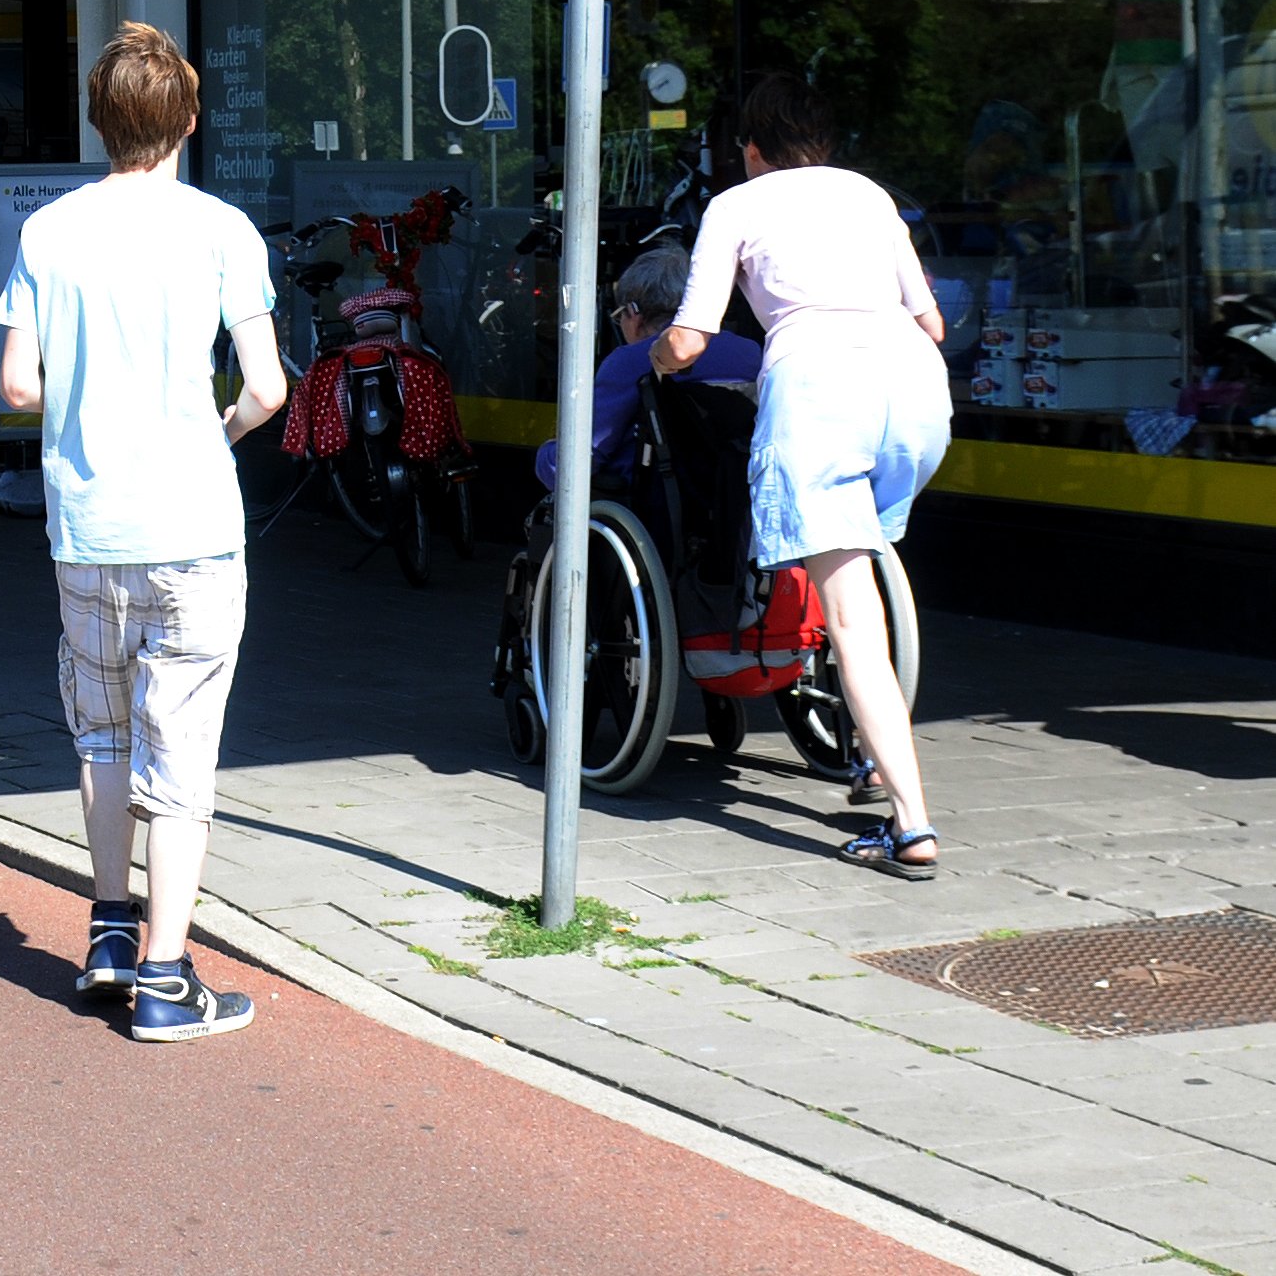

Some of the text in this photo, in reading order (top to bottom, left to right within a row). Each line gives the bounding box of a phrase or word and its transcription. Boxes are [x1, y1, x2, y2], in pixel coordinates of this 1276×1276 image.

[226, 26, 262, 48] Kleding
[205, 47, 247, 69] Kaarten
[226, 87, 264, 109] Gidsen
[210, 109, 241, 128] Reizen
[221, 130, 283, 151] Verzekeringen
[215, 151, 275, 187] Pechhulp
[12, 185, 35, 197] Alle
